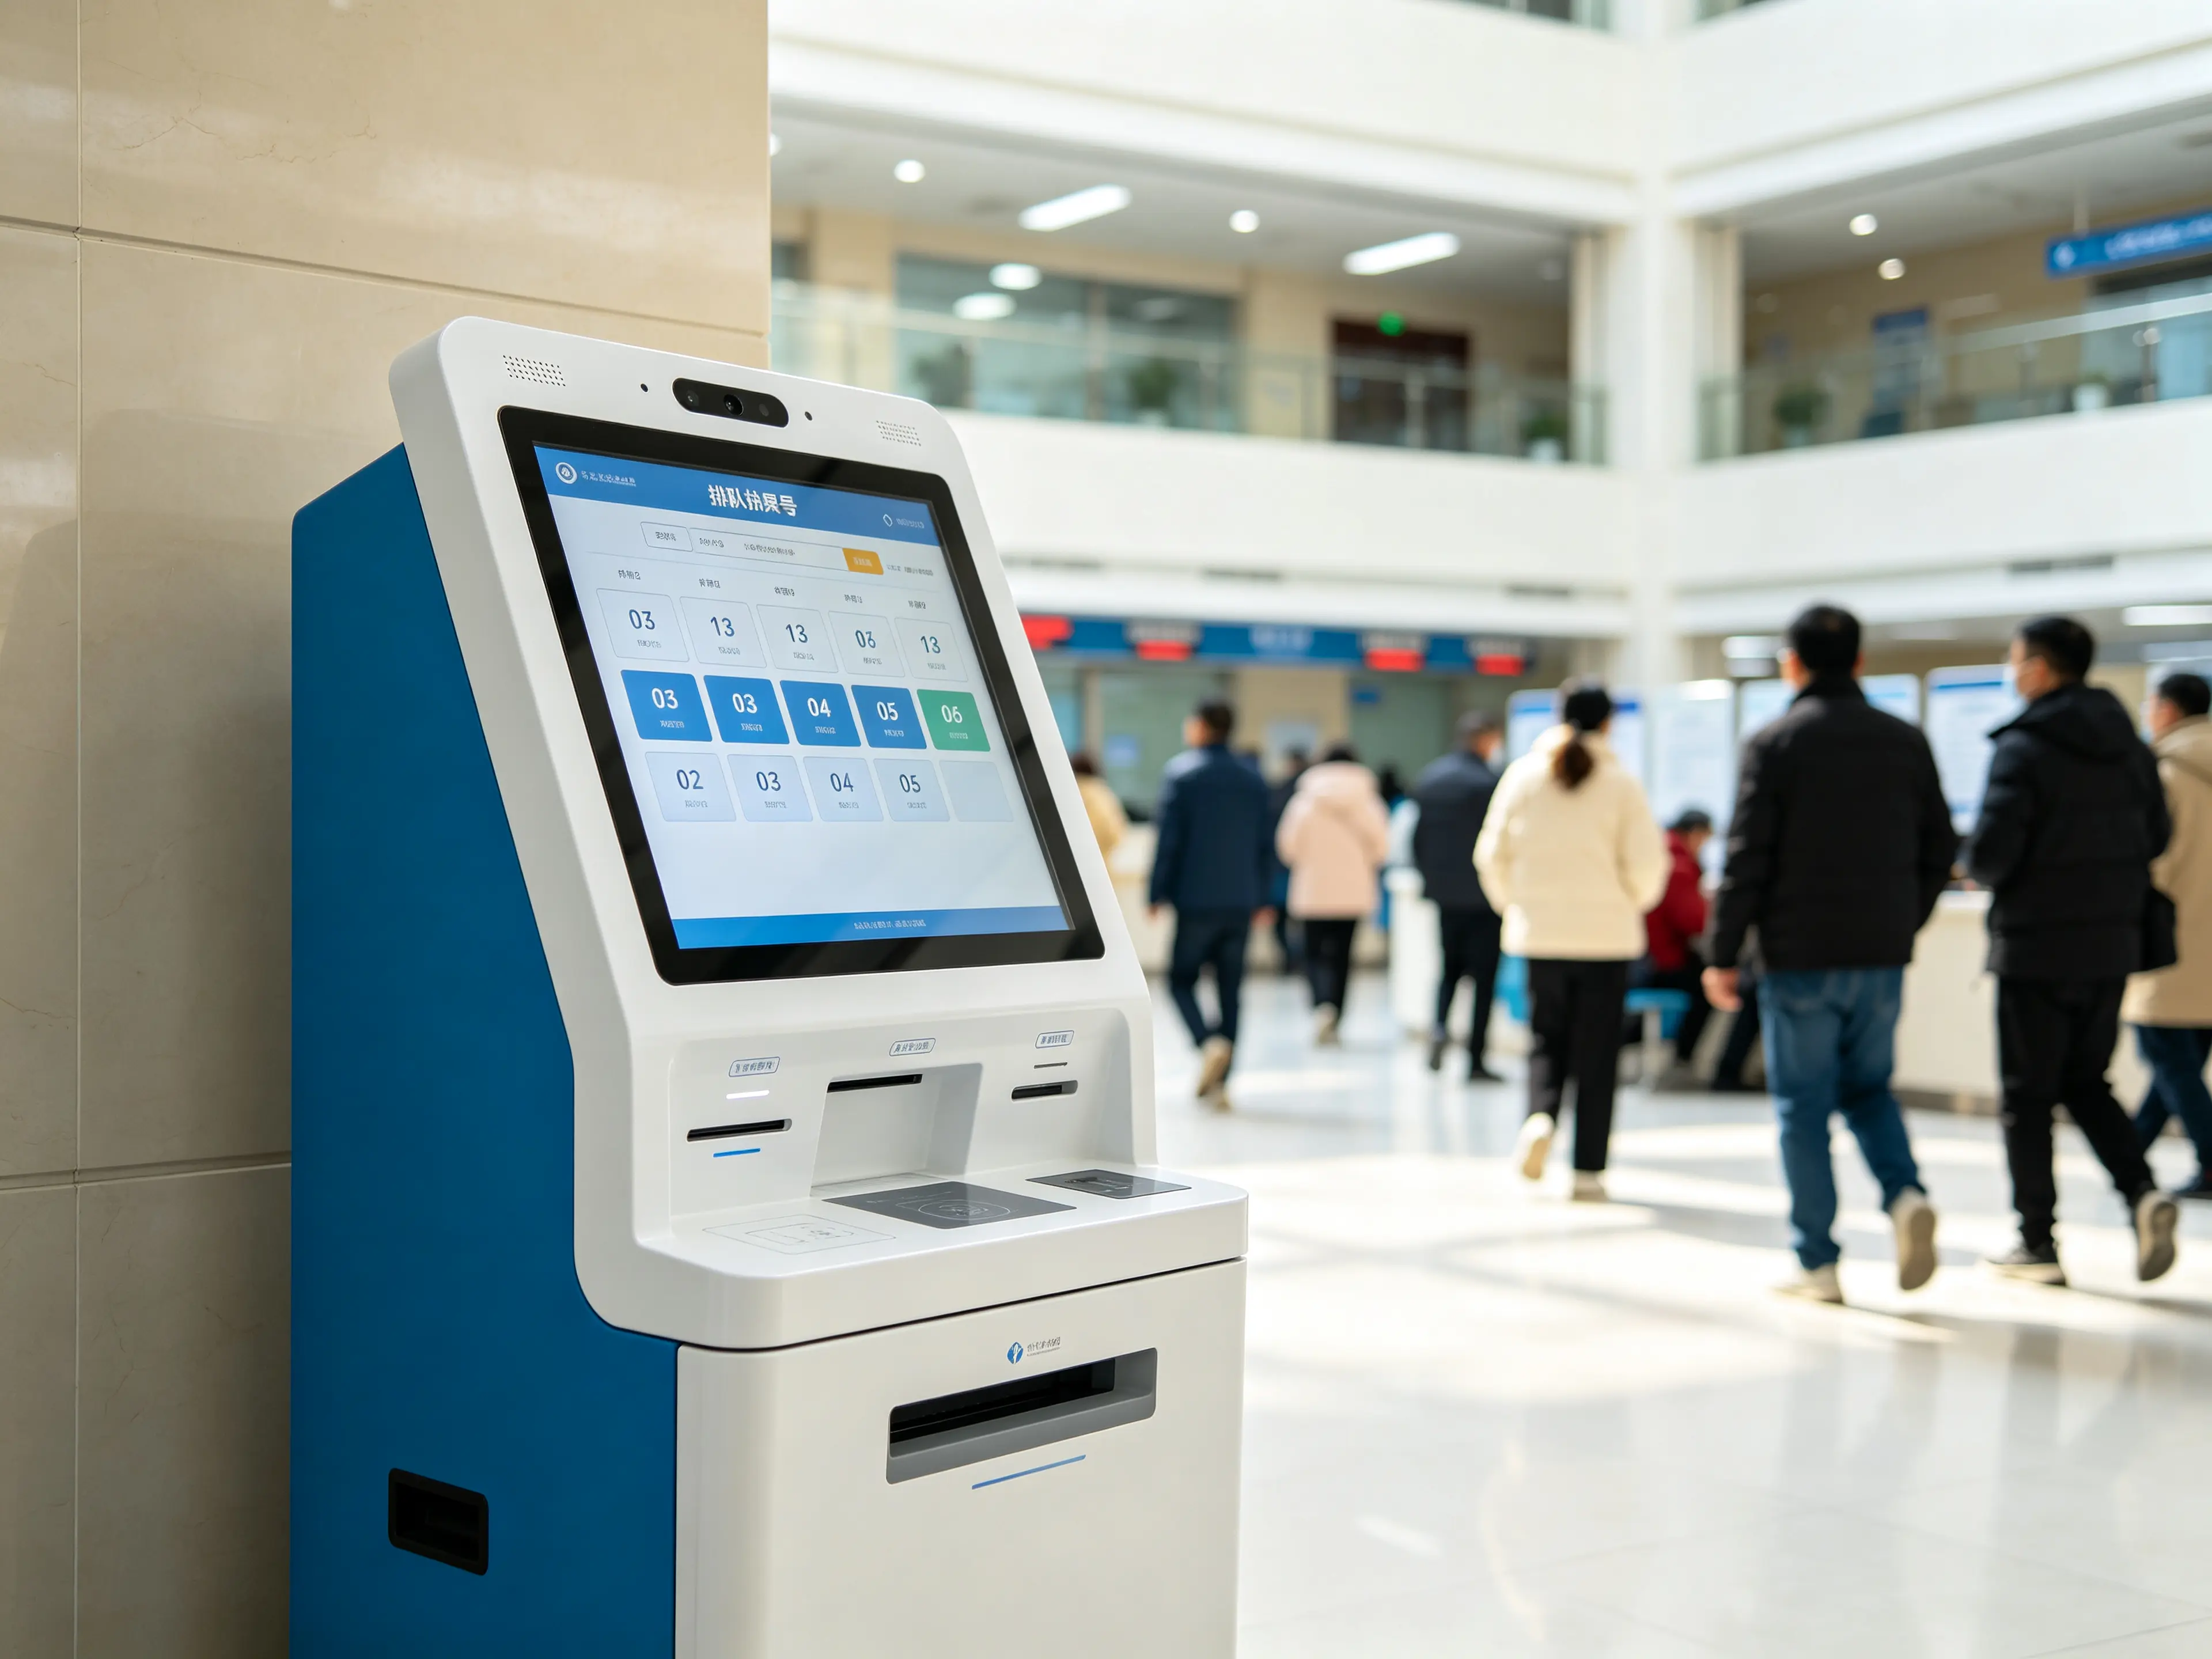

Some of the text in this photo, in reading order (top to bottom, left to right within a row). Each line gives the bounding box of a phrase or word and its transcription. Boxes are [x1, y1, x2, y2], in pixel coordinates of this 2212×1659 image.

[629, 609, 655, 630] 03
[711, 617, 734, 637] 13
[786, 624, 808, 643] 13
[921, 636, 940, 653] 13
[652, 688, 678, 709] 03
[733, 694, 757, 713] 03
[808, 698, 831, 717] 04
[877, 702, 898, 720] 05
[942, 705, 963, 723] 06
[677, 770, 703, 789] 02
[756, 772, 781, 791] 03
[831, 773, 853, 791] 04
[900, 774, 921, 793] 05
